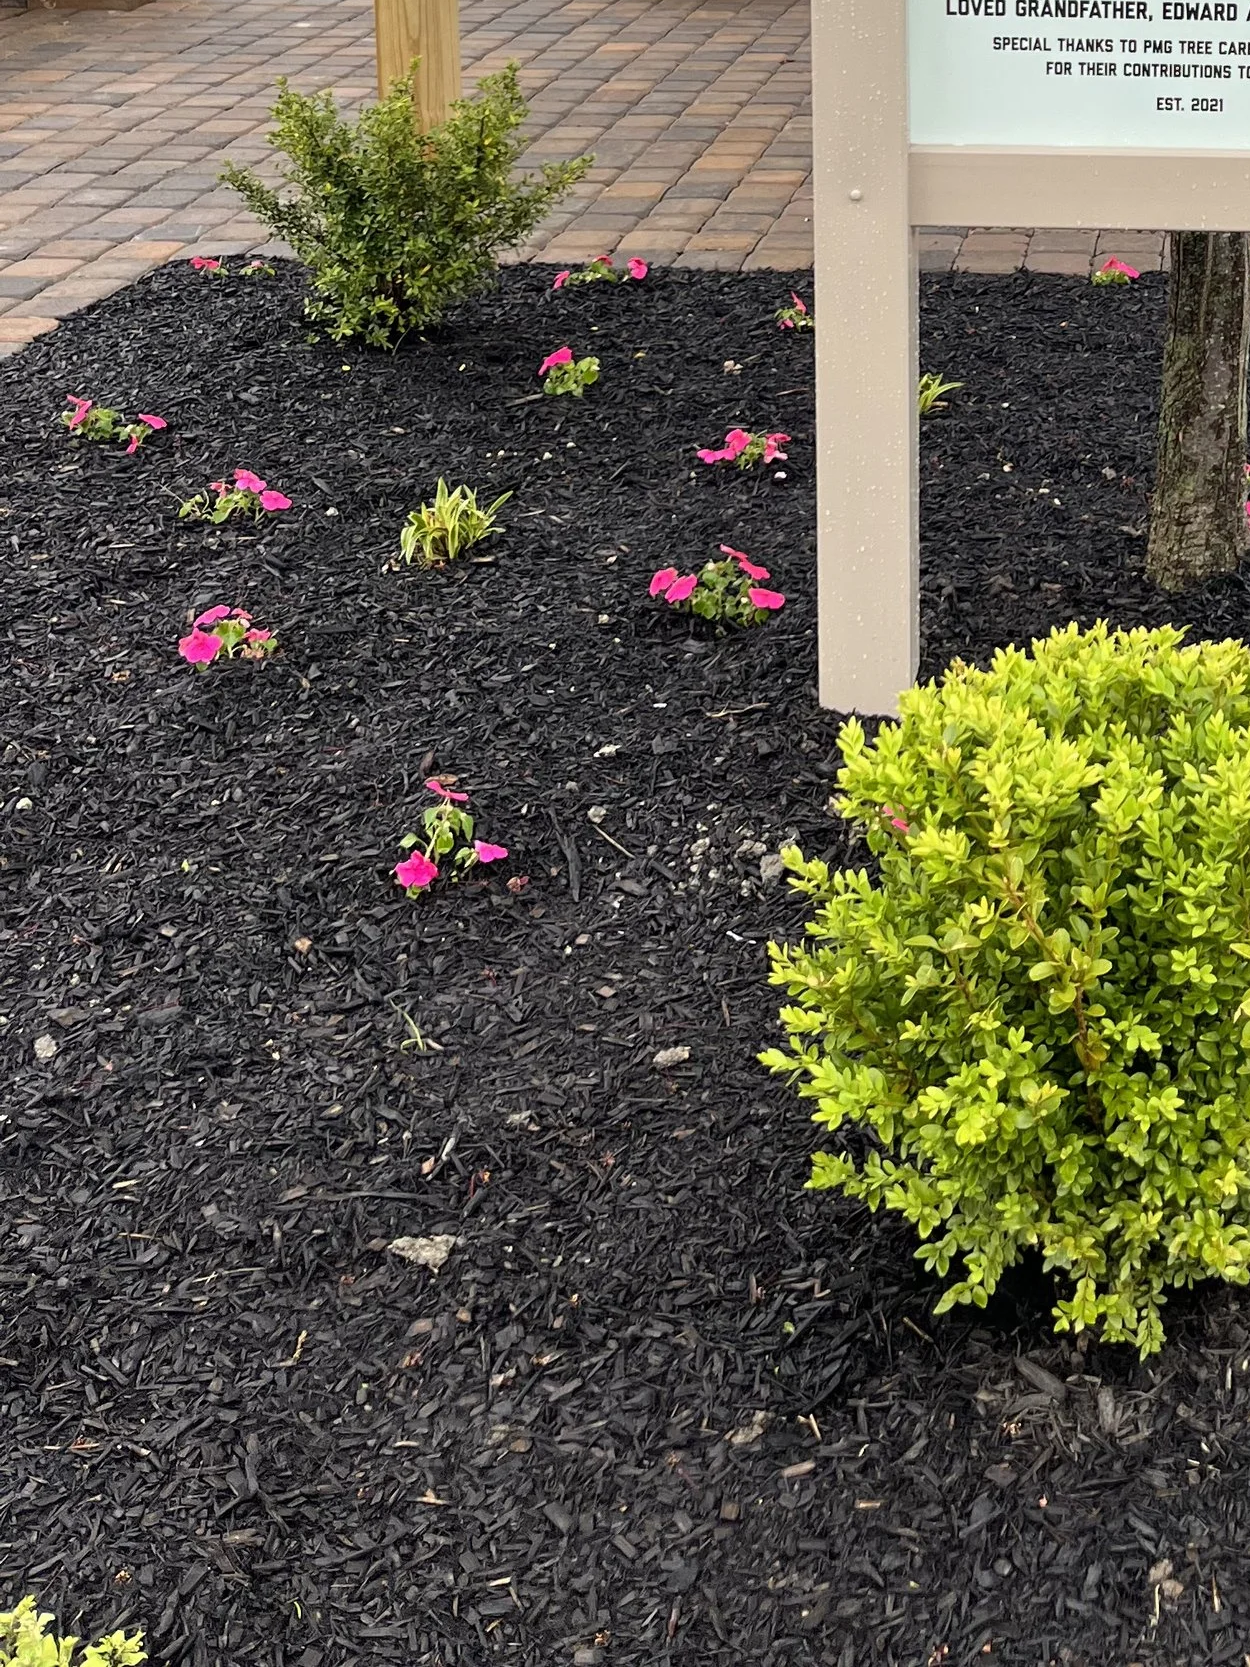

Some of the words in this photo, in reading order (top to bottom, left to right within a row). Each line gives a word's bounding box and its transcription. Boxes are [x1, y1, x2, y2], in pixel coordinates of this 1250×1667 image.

[1162, 1, 1238, 22] EDWARD
[992, 36, 1052, 52] SPECIAL
[1056, 37, 1114, 53] THANKS
[1119, 38, 1138, 54] TO
[1143, 39, 1173, 54] PMG
[1178, 40, 1213, 55] TREE
[1045, 61, 1073, 76] FOR
[1077, 61, 1118, 77] THEIR
[1123, 62, 1232, 79] CONTRIBUTIONS
[1156, 96, 1185, 112] EST.
[1191, 97, 1224, 113] 2021
